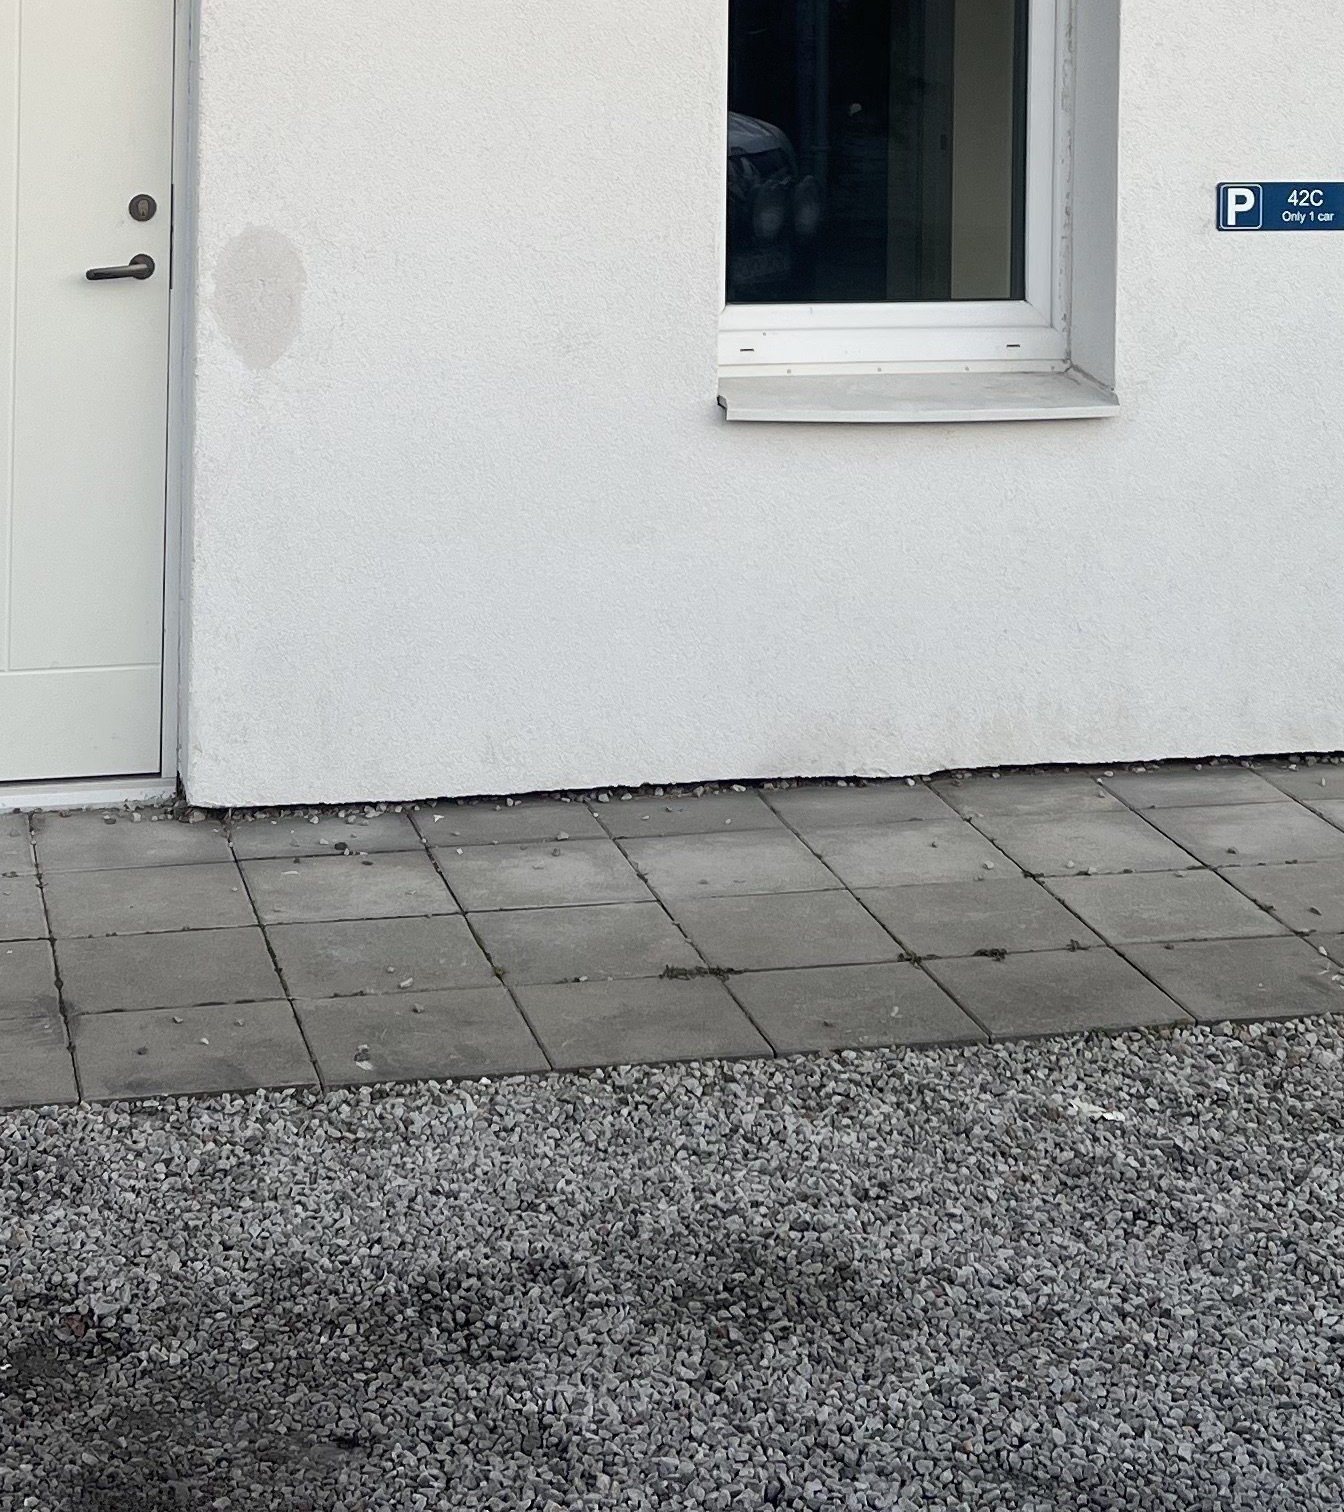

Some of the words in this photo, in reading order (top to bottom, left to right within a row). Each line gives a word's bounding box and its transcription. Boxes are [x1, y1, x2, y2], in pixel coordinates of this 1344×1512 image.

[1227, 187, 1255, 226] P
[1287, 189, 1324, 207] 42C
[1281, 210, 1306, 224] Only
[1309, 211, 1315, 221] 1
[1317, 212, 1335, 222] car
